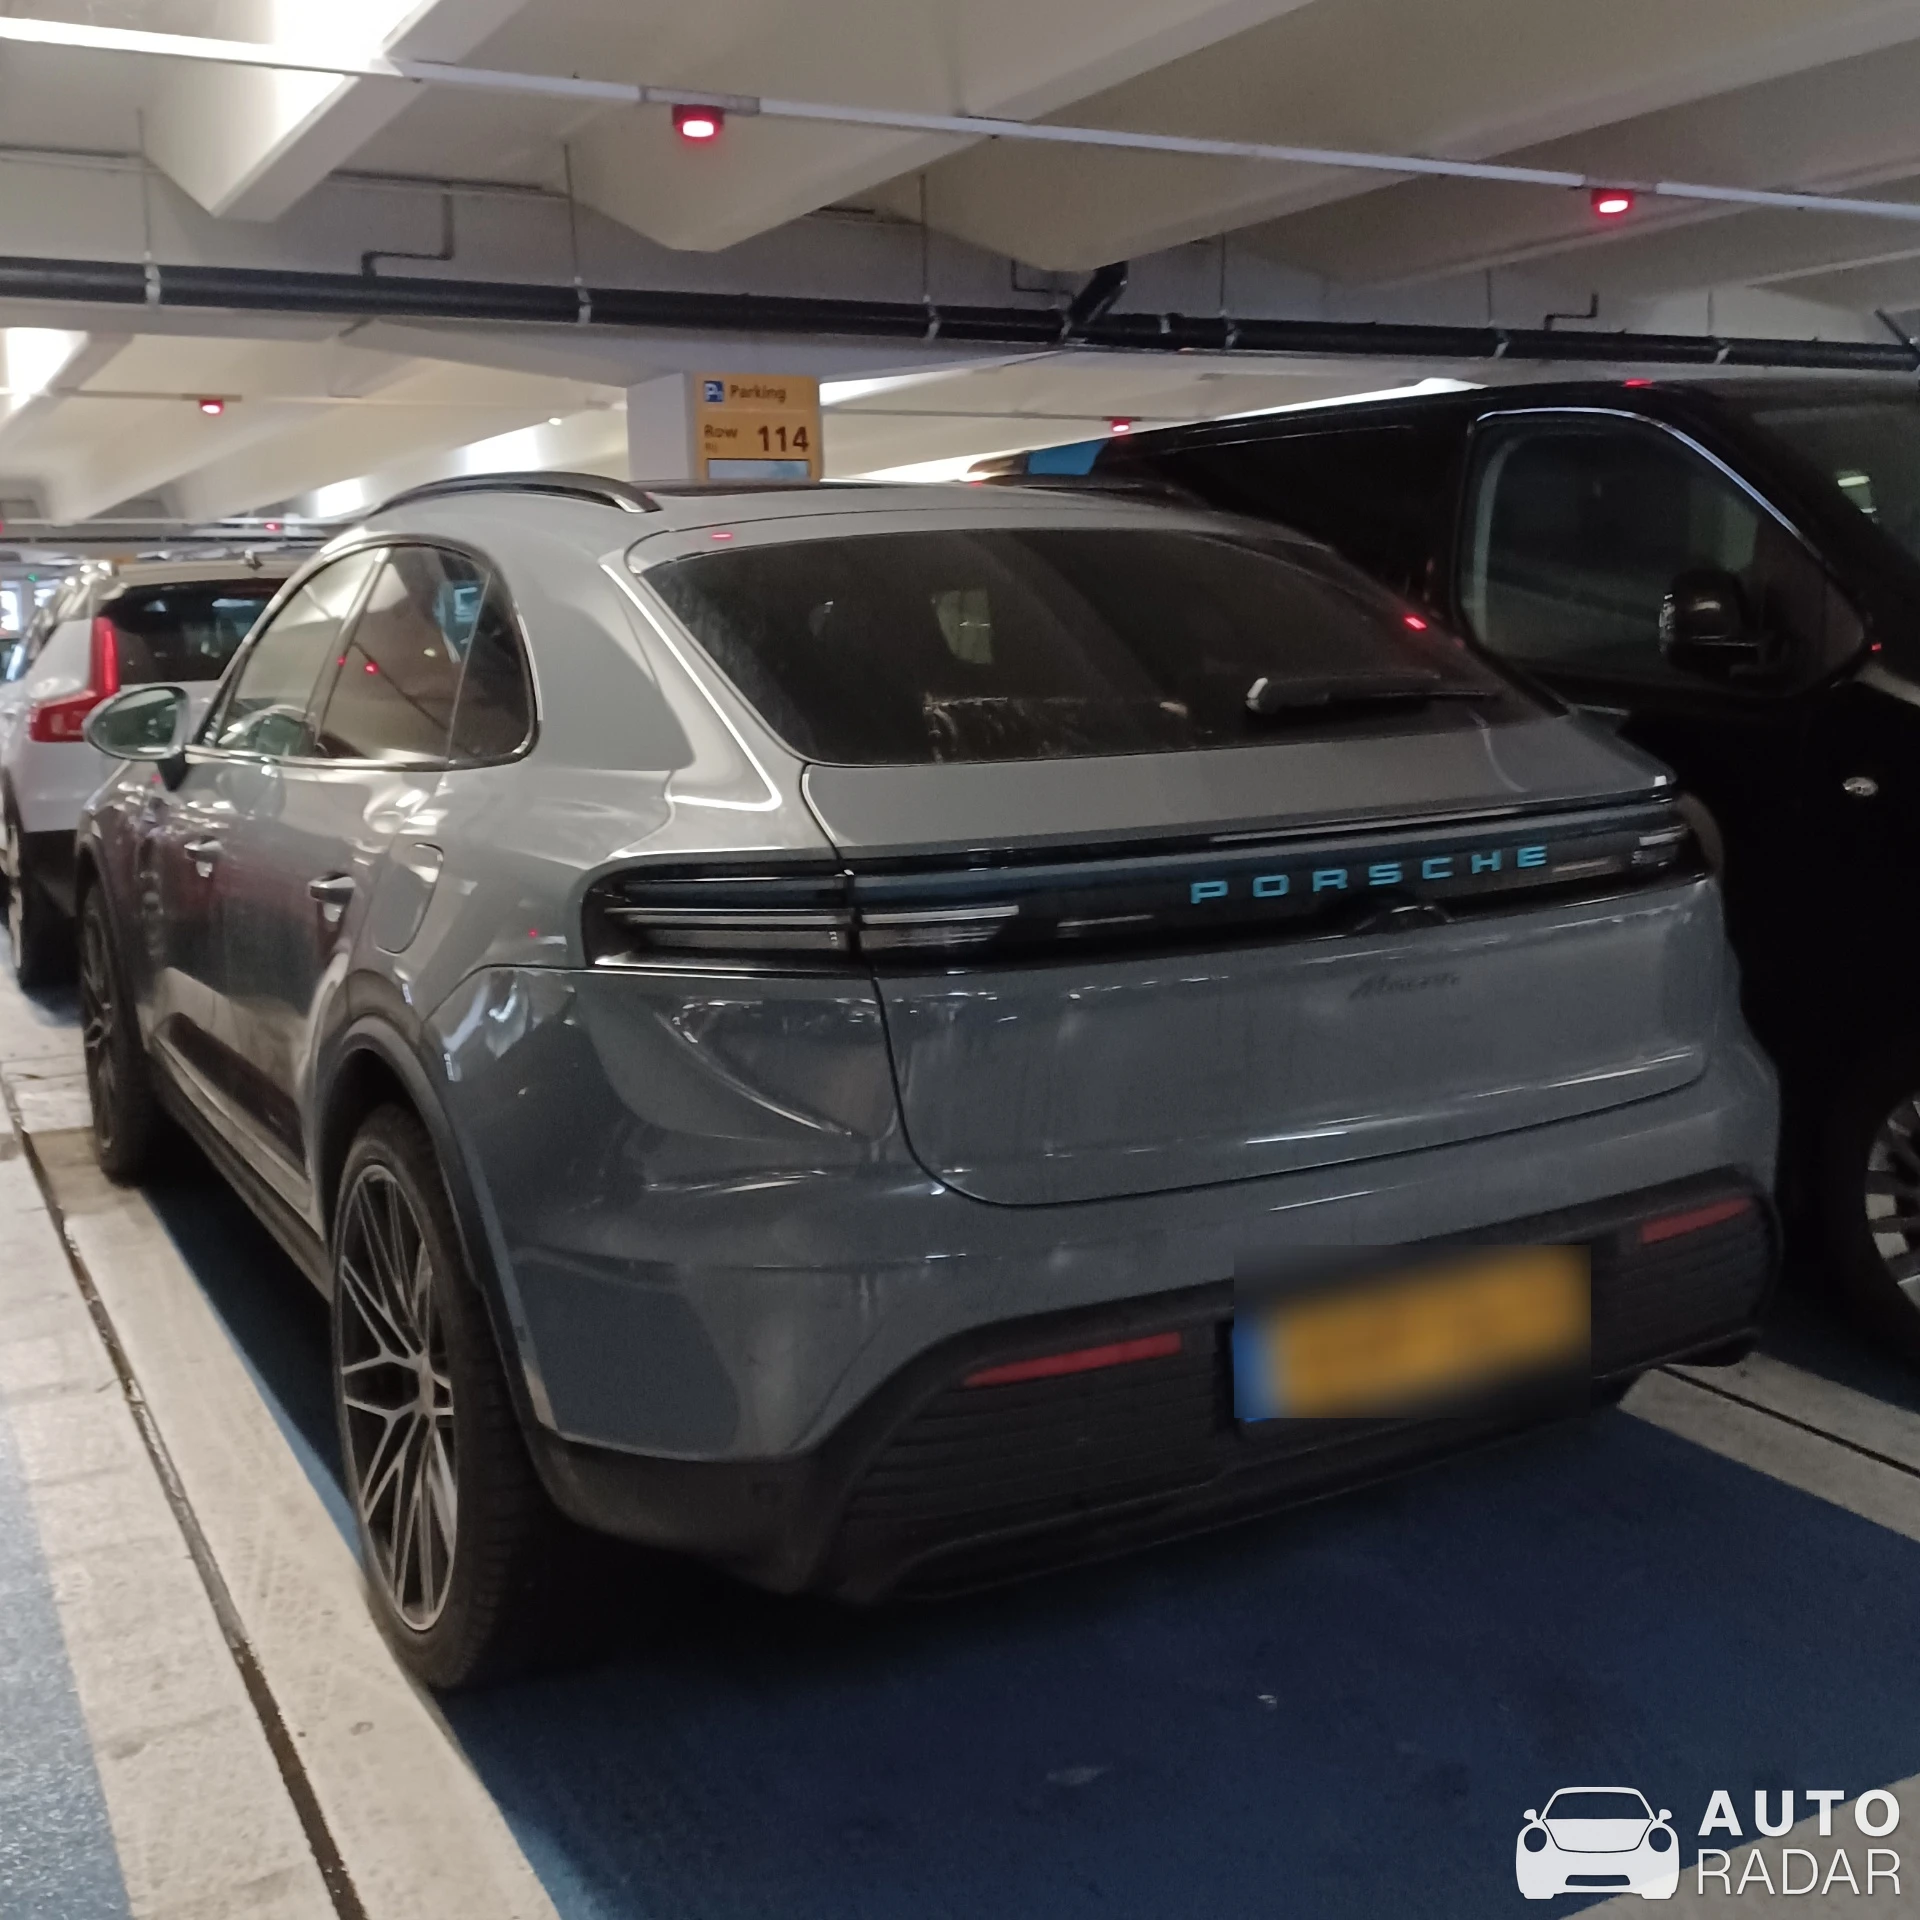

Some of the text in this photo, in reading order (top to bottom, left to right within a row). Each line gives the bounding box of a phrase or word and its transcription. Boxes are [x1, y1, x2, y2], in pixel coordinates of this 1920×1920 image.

[730, 384, 786, 403] Parking
[704, 424, 810, 452] Row 114
[1190, 845, 1548, 904] PORSCHE
